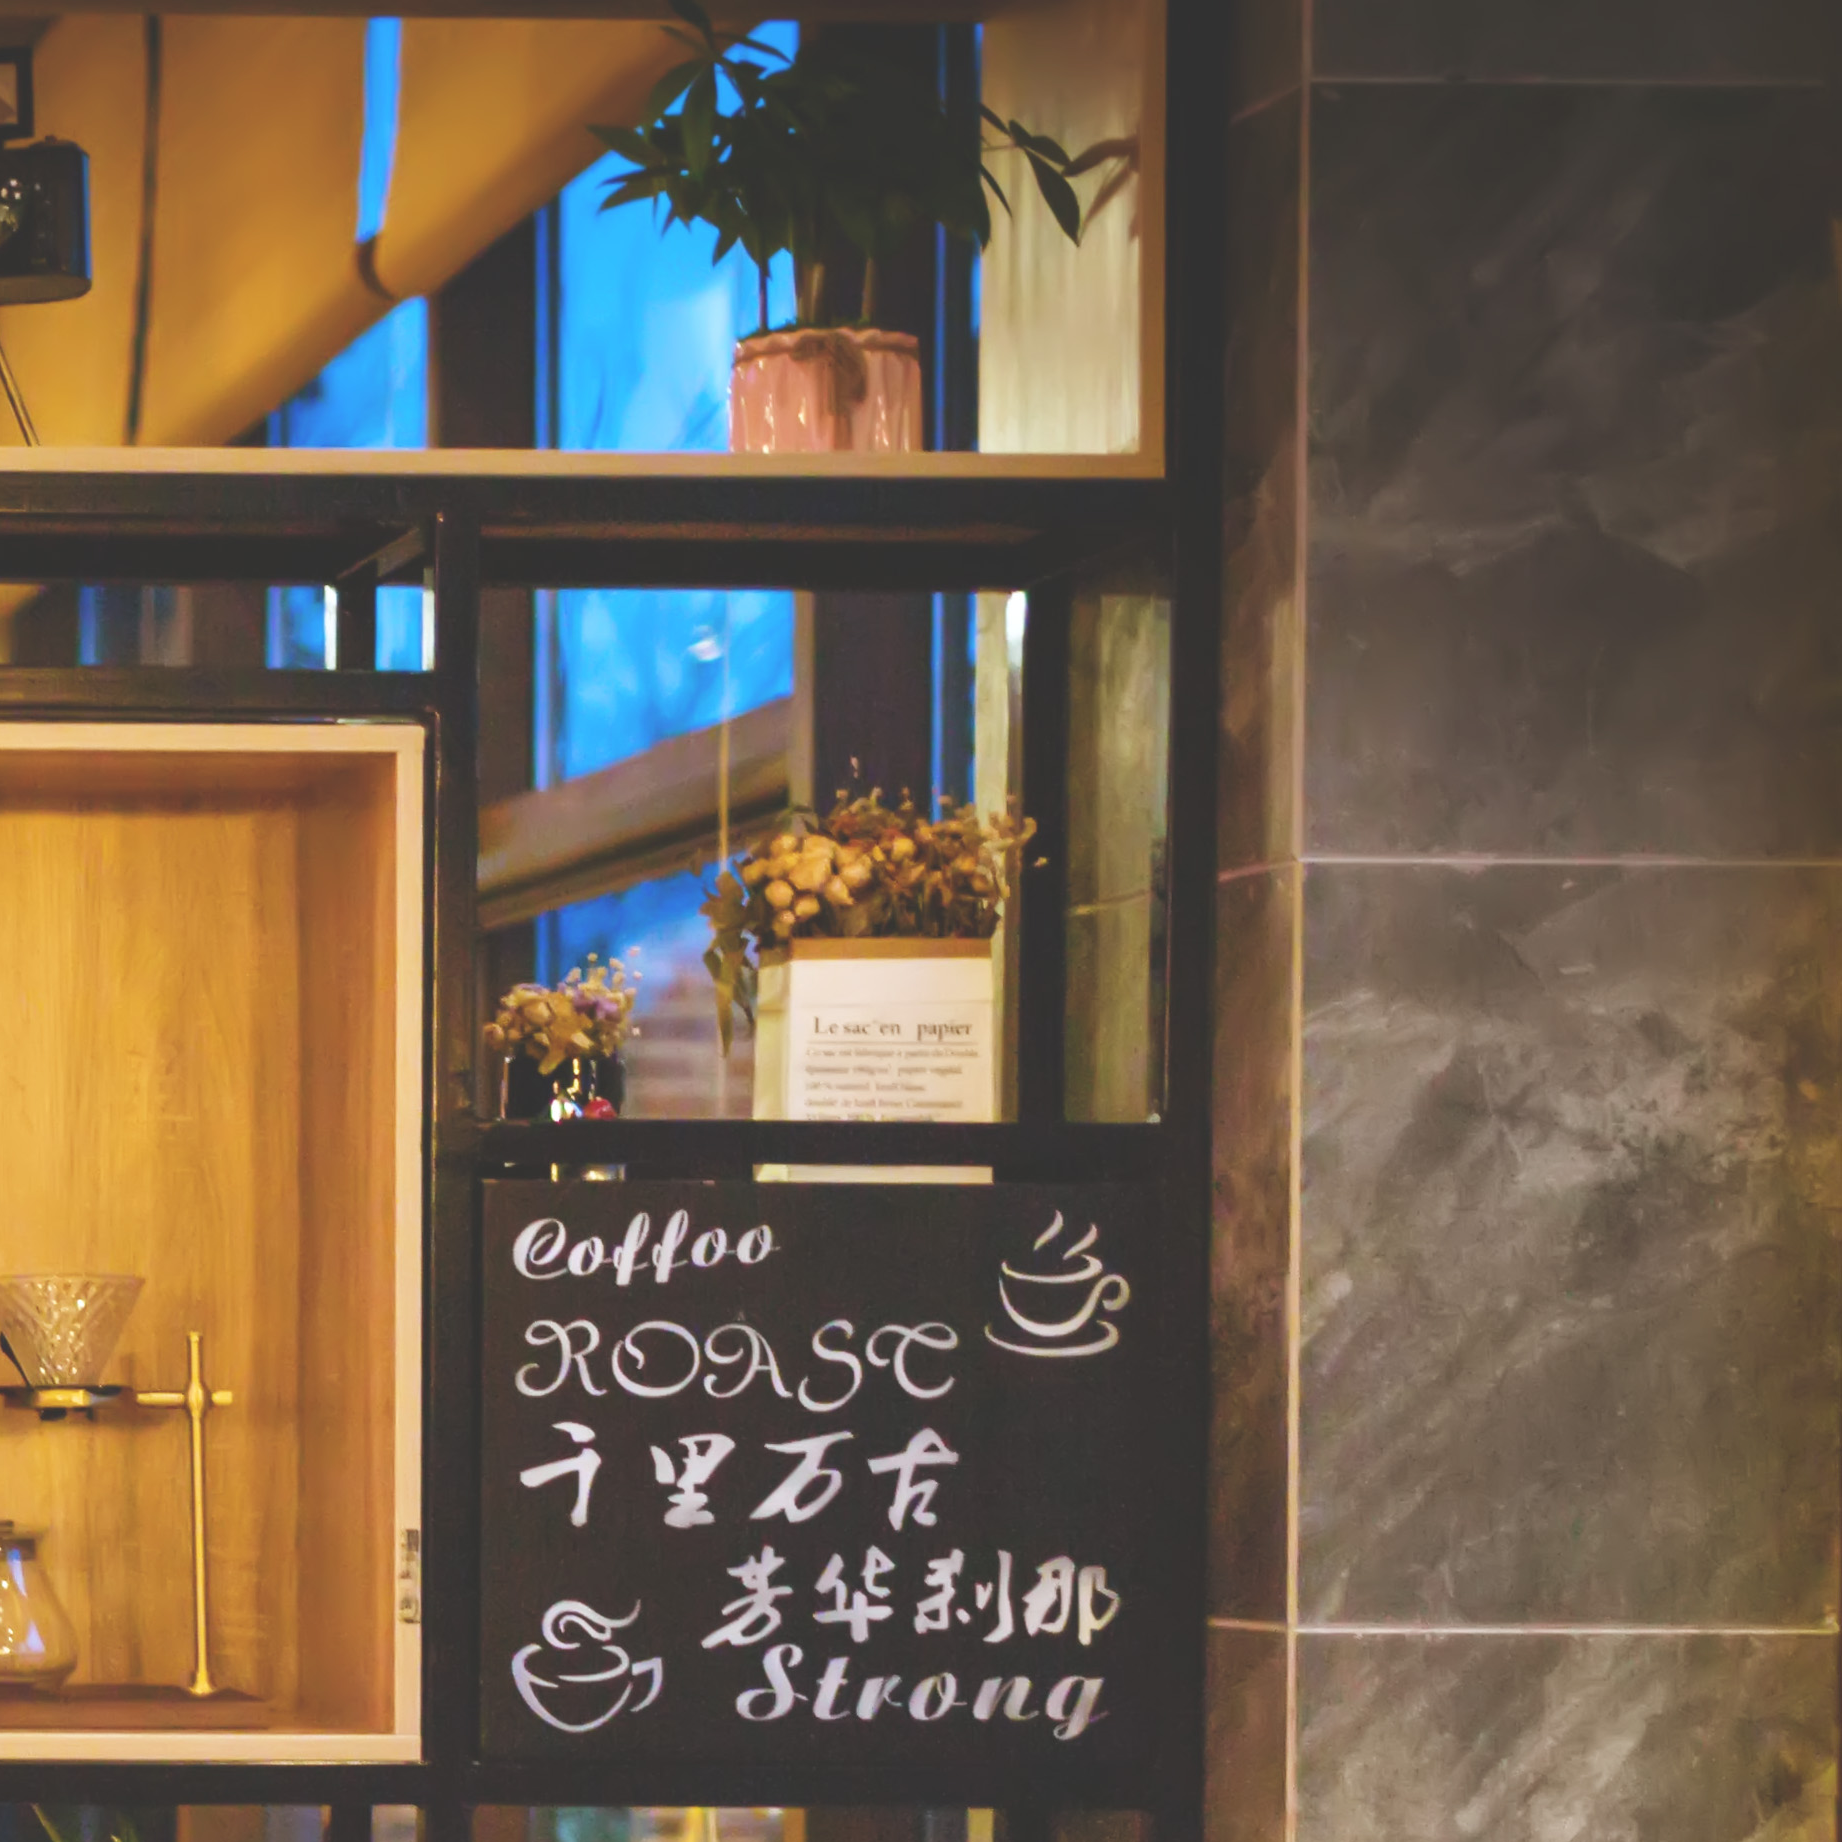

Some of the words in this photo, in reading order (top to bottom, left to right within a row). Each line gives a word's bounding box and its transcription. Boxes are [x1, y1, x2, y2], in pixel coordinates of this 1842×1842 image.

[814, 1016, 838, 1035] Le
[916, 1020, 973, 1041] papier
[520, 1422, 958, 1530] 千里万古
[736, 1644, 1106, 1740] Strong
